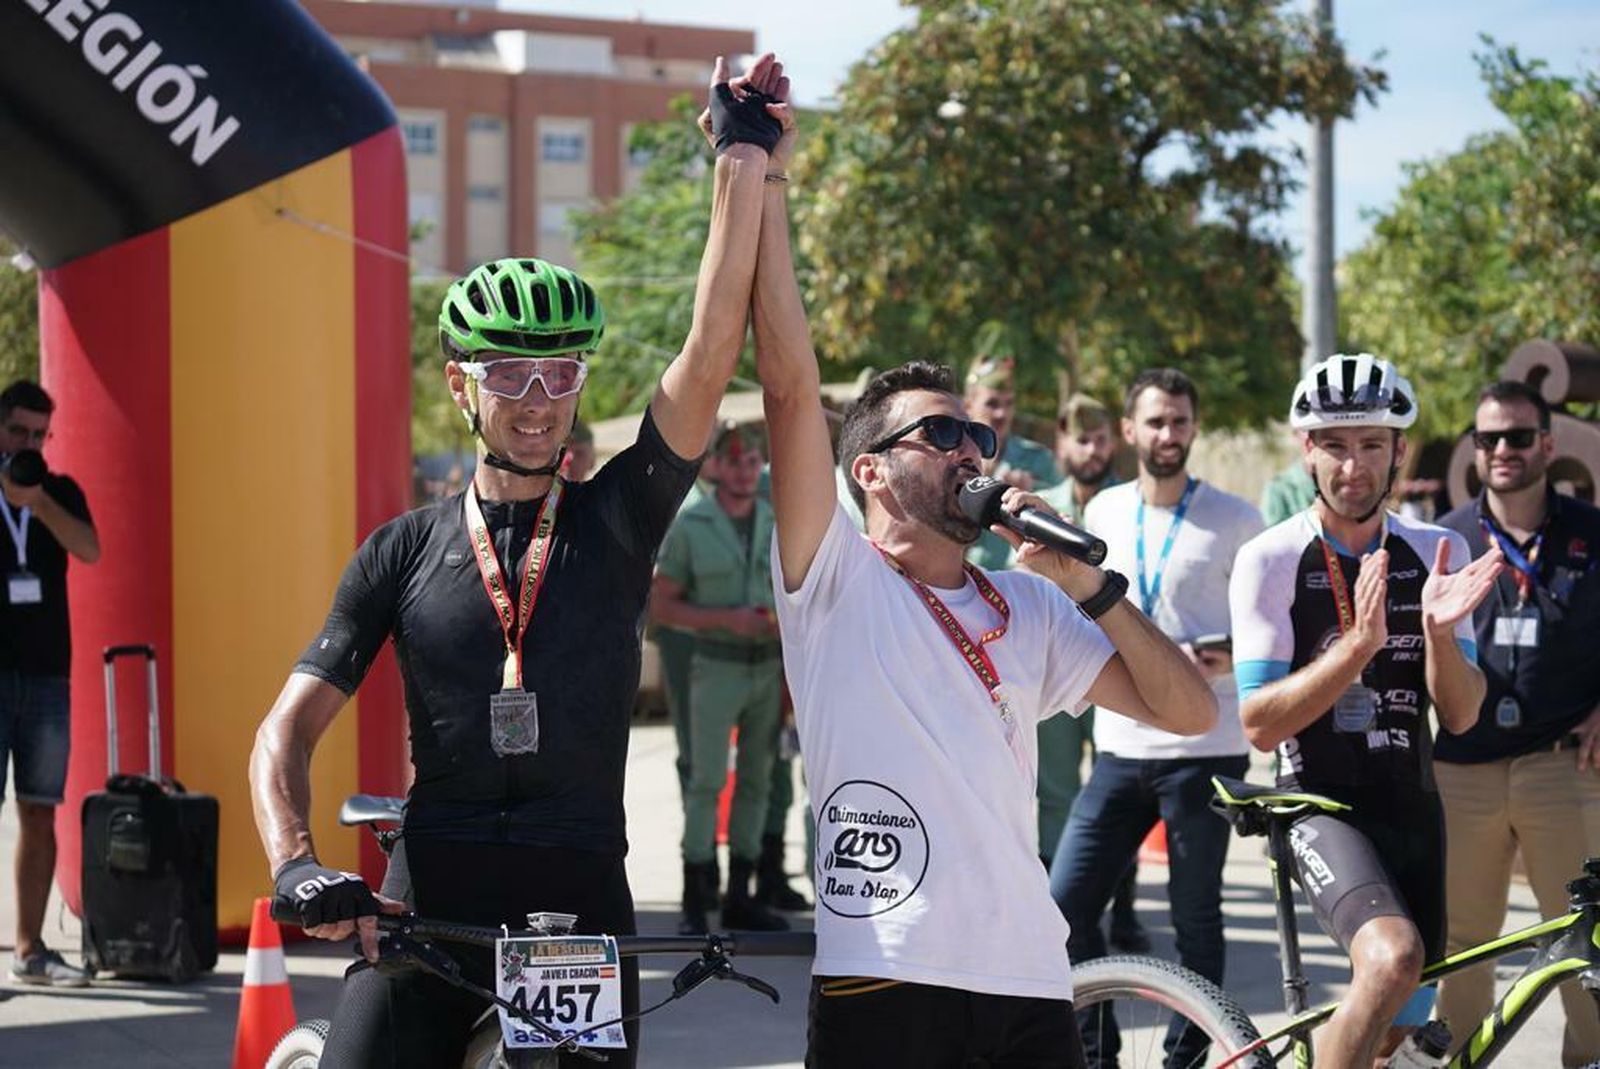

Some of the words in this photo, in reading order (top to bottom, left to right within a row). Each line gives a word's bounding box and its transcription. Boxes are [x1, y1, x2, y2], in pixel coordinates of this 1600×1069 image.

[25, 0, 240, 166] EGIÓN
[825, 876, 855, 897] Non
[540, 968, 567, 980] JAVIER
[507, 984, 601, 1025] 4457
